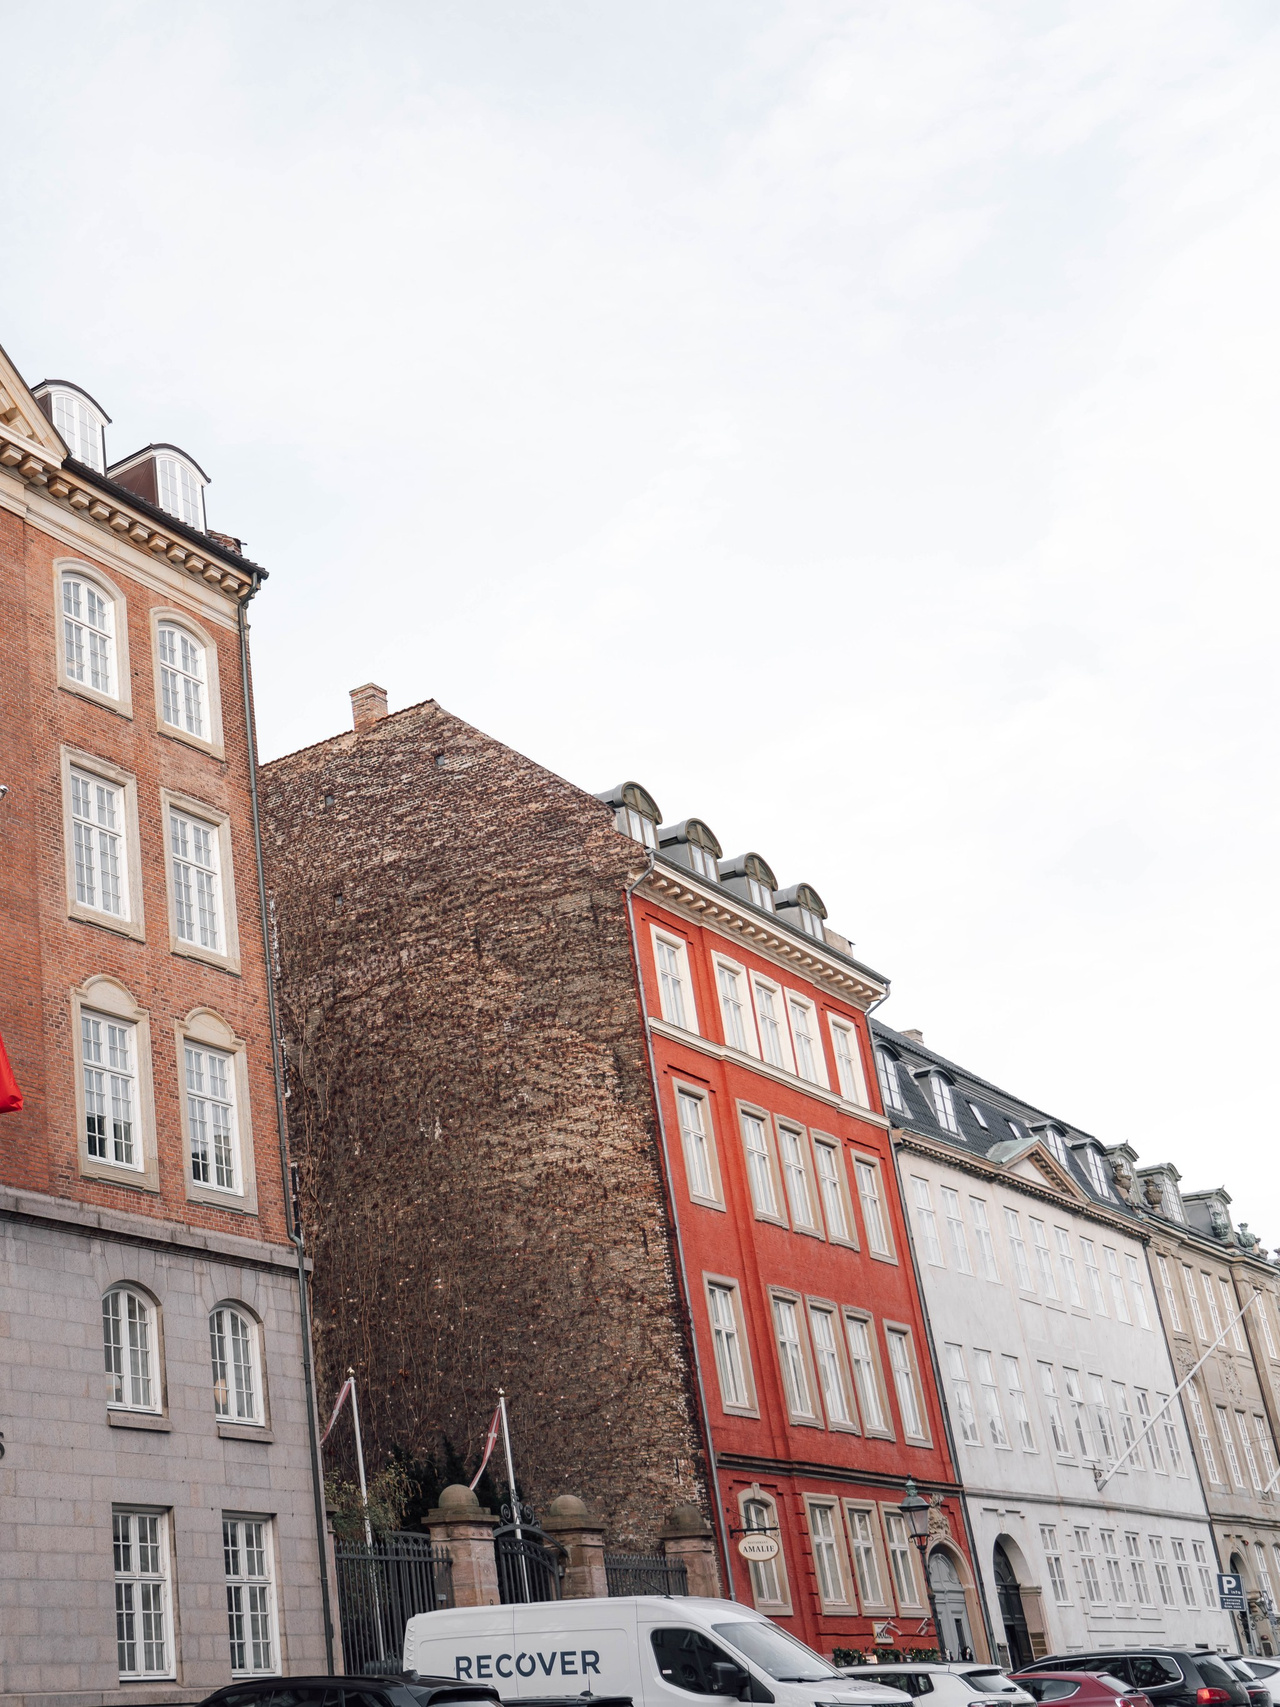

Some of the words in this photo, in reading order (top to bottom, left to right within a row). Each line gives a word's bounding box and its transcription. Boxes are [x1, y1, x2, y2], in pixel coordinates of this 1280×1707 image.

[743, 1545, 775, 1553] AMALIE
[1222, 1576, 1236, 1594] P
[455, 1650, 601, 1679] RECOVER
